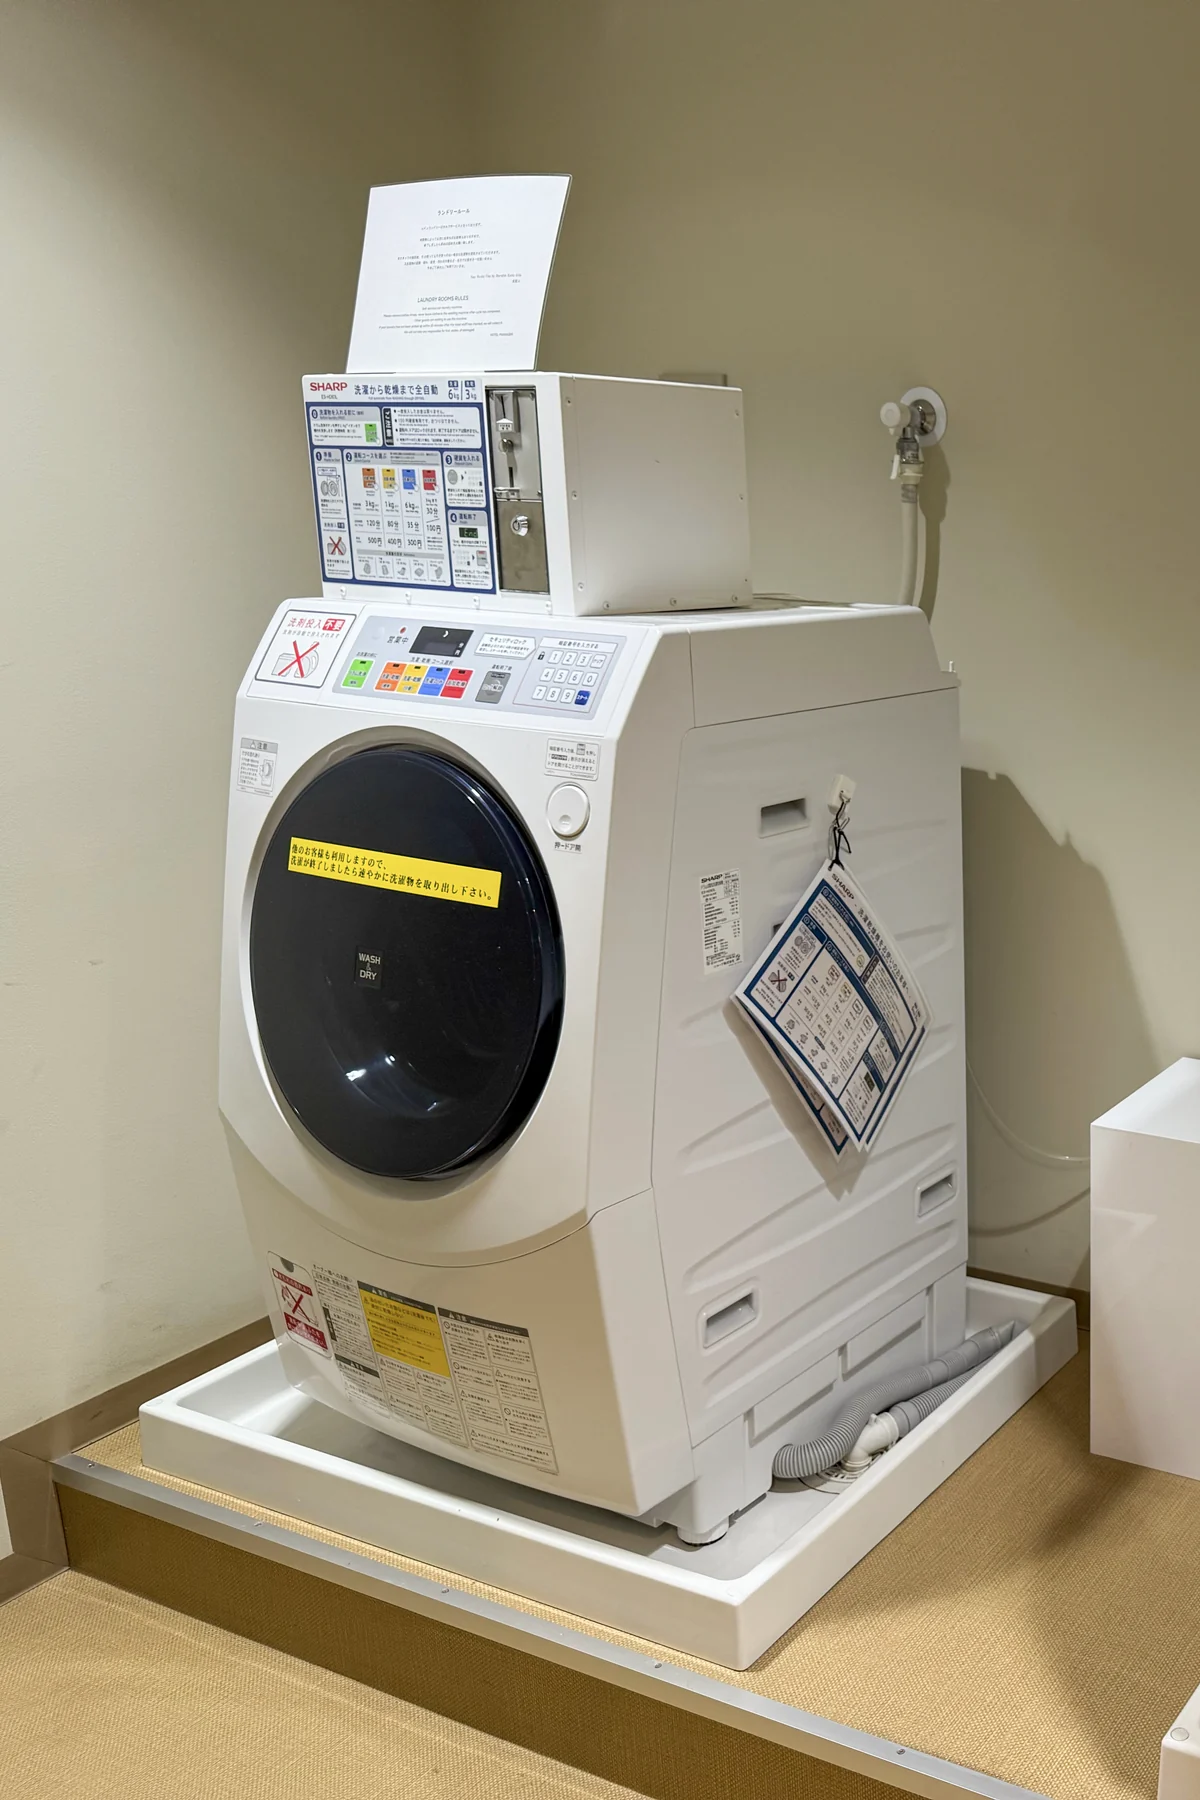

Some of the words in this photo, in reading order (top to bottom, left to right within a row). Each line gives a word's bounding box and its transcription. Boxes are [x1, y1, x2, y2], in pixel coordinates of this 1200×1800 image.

[310, 382, 347, 391] SHARP
[354, 384, 439, 395] 洗濯から乾燥まで全自動
[287, 618, 322, 628] 洗剤投入
[387, 636, 409, 644] 営業中
[292, 844, 387, 870] 他のお客様も利用しますので、
[290, 856, 492, 900] 洗濯が終了しましたら速やかに洗濯物を取り出し下さい。
[831, 873, 855, 900] SHARP
[358, 952, 381, 964] WASH
[360, 969, 377, 981] DRY
